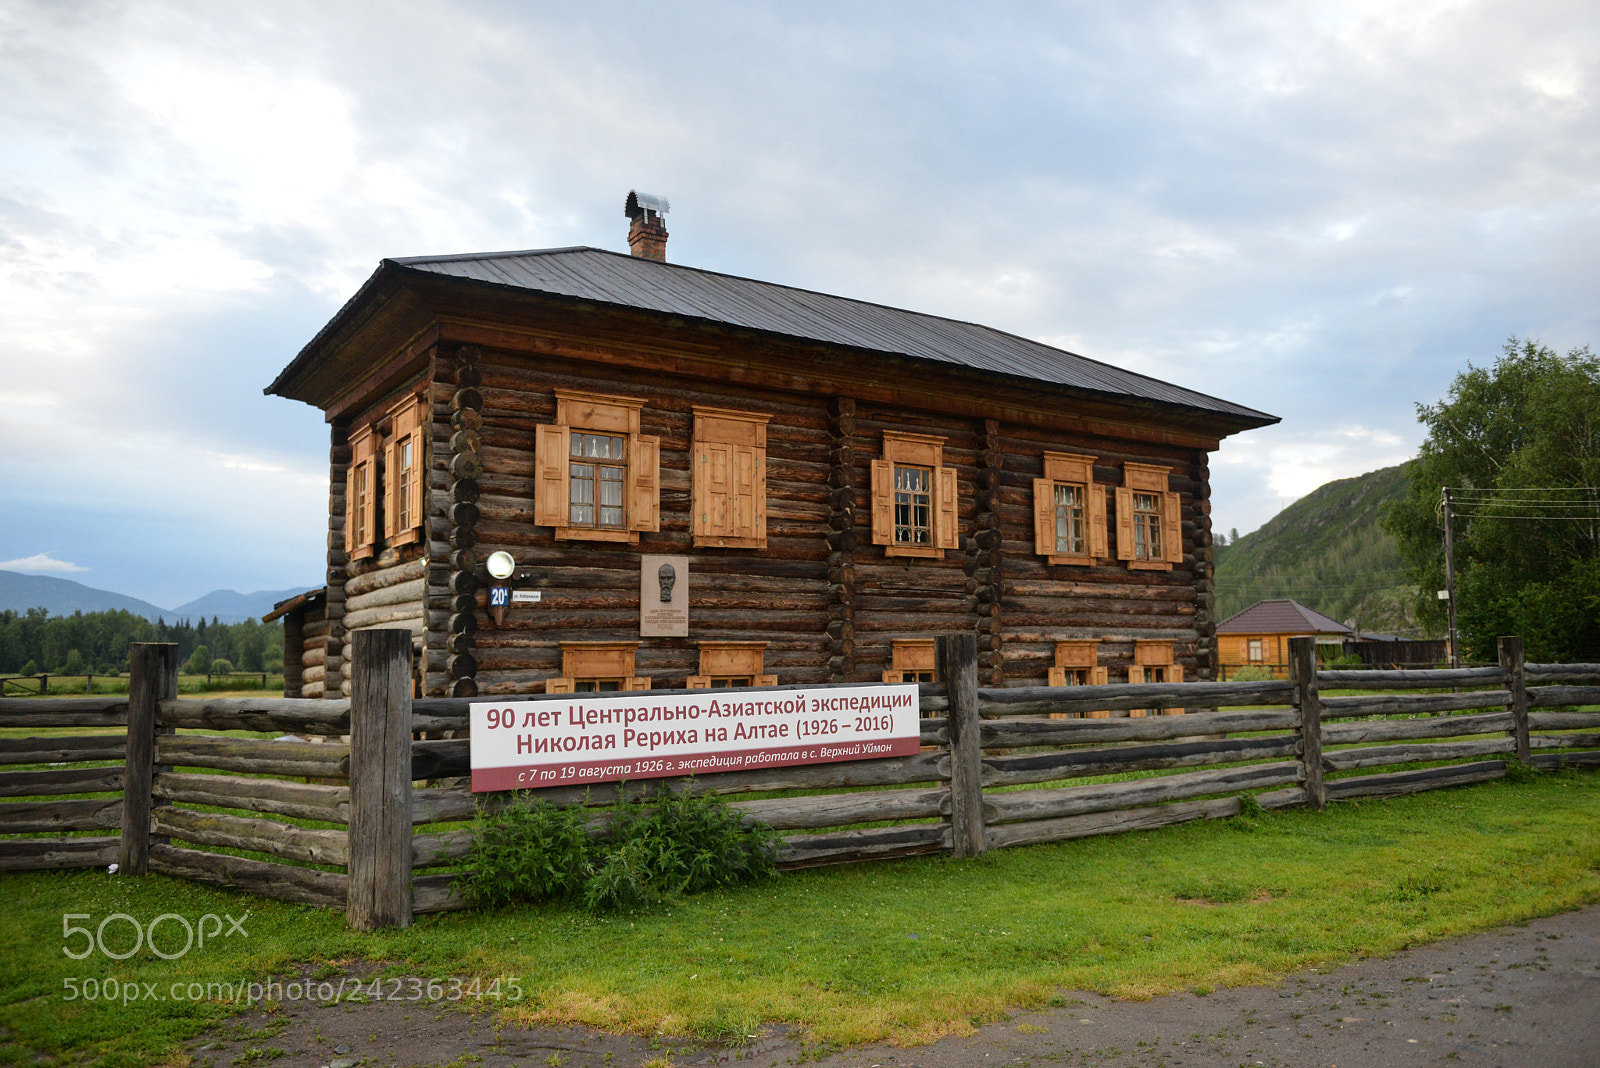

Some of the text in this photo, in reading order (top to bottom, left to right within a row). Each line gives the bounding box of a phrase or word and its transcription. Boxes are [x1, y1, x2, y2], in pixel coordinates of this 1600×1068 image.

[486, 693, 912, 730] 90 лет Центрально-Азиатской экспедиции
[516, 733, 616, 755] Николая
[623, 728, 698, 751] Рериха
[705, 726, 728, 743] на
[733, 721, 789, 742] Алтае
[518, 741, 892, 782] с 7 по 19 августа 1926 г. экспедиция работала в с. Верхний Уймон
